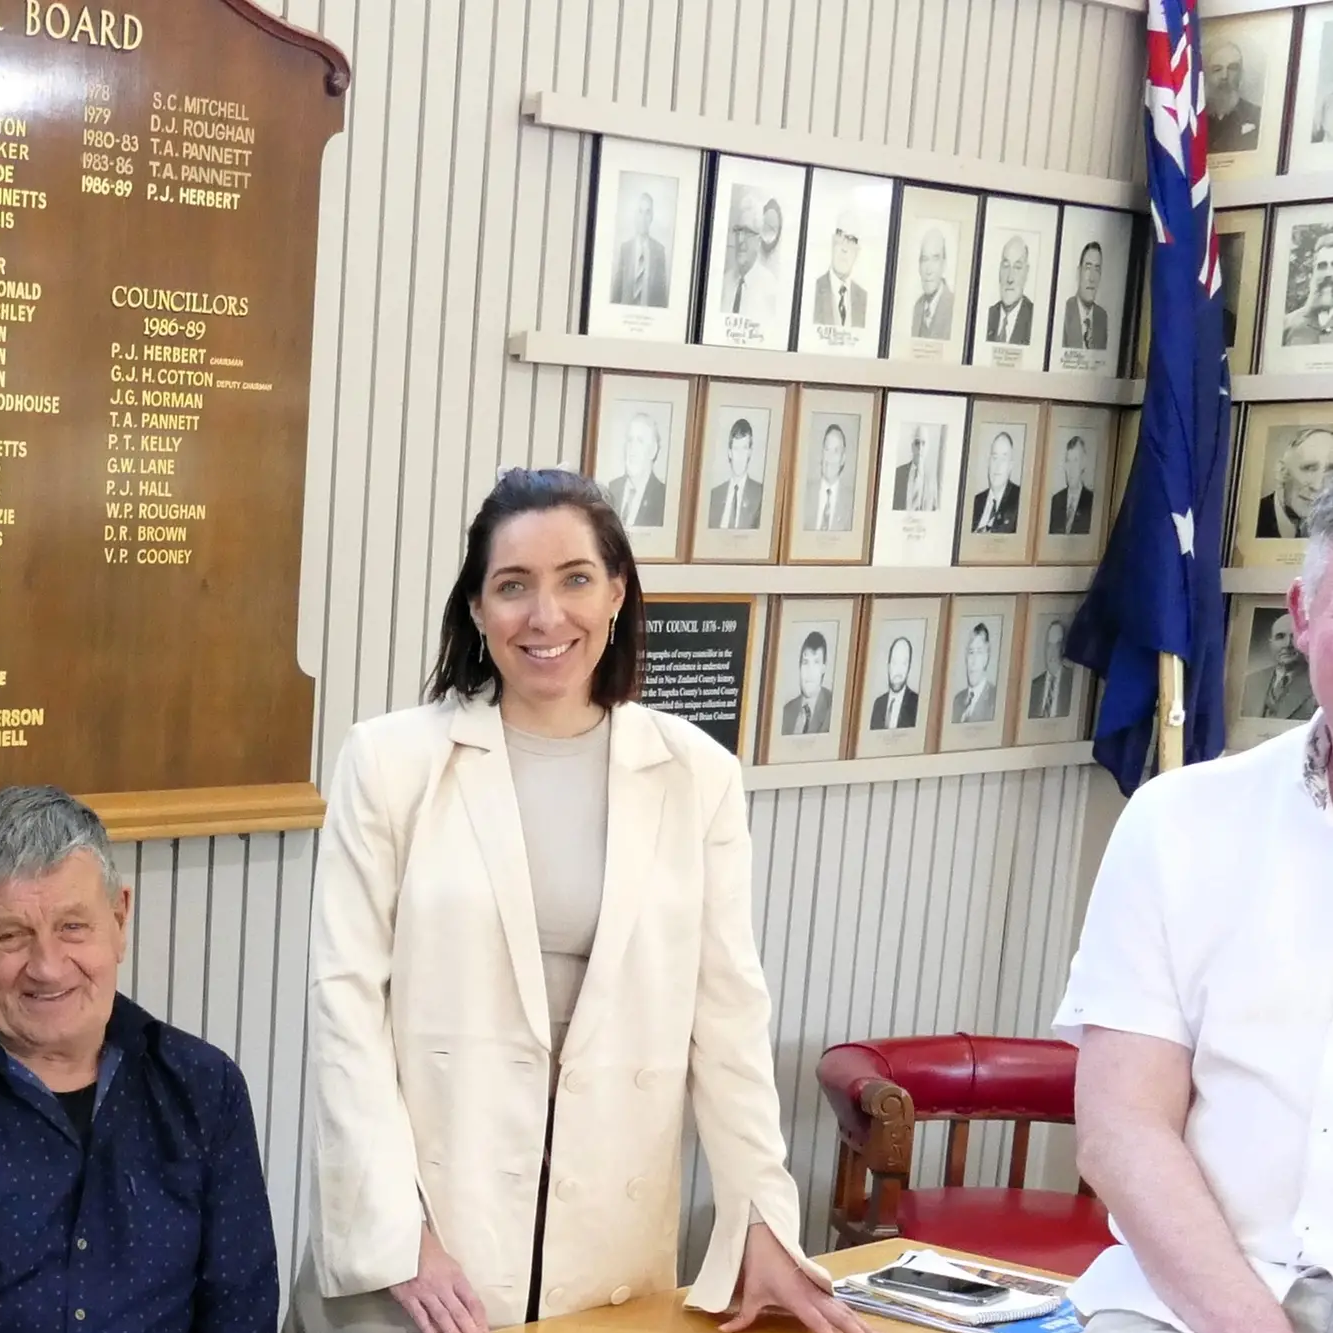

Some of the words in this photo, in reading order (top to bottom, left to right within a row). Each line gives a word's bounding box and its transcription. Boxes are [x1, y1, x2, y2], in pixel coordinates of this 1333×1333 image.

[26, 1, 144, 51] BOARD
[85, 106, 111, 124] 1979
[184, 96, 249, 121] MITCHELL
[84, 129, 139, 152] 1980-83
[183, 119, 254, 144] ROUGHAN
[83, 152, 133, 174] 1983-86
[183, 142, 252, 166] PANNETT
[82, 175, 132, 197] 1986-89
[181, 165, 251, 188] PANNETT
[179, 187, 240, 210] HERBERT
[112, 286, 248, 316] COUNCILLORS
[144, 317, 206, 340] 1986-89
[144, 345, 206, 364] HERBERT
[158, 369, 213, 387] COTTON
[142, 390, 203, 409] NORMAN
[142, 413, 199, 430] PANNETT
[141, 436, 182, 452] KELLY
[141, 459, 174, 474] LANE
[139, 481, 172, 497] HALL
[139, 503, 205, 519] ROUGHAN
[138, 526, 186, 542] BROWN
[137, 548, 192, 564] COONEY
[666, 620, 699, 633] COUNCIL
